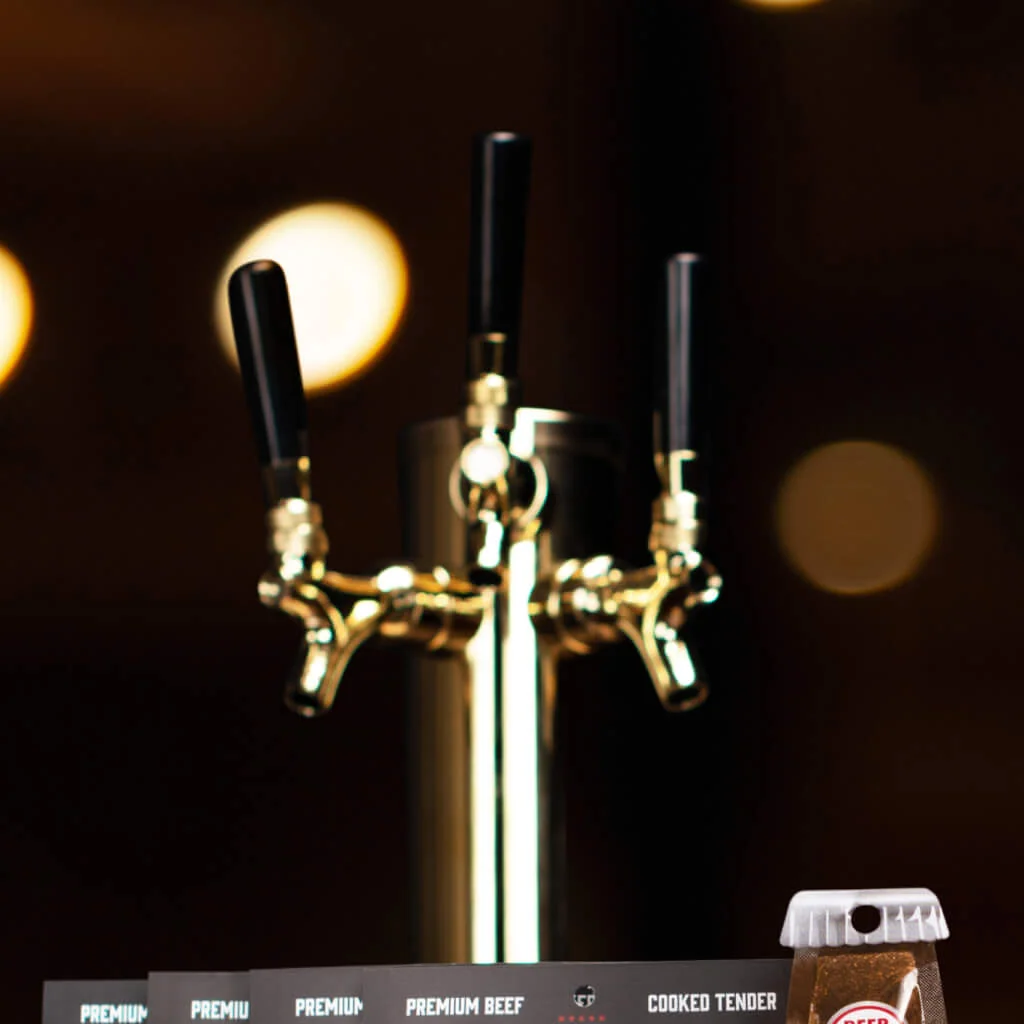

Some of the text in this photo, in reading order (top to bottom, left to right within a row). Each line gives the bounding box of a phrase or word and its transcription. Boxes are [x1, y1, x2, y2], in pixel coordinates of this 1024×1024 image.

[406, 996, 525, 1016] PREMIUM BEEF
[648, 992, 777, 1013] COOKED TENDER
